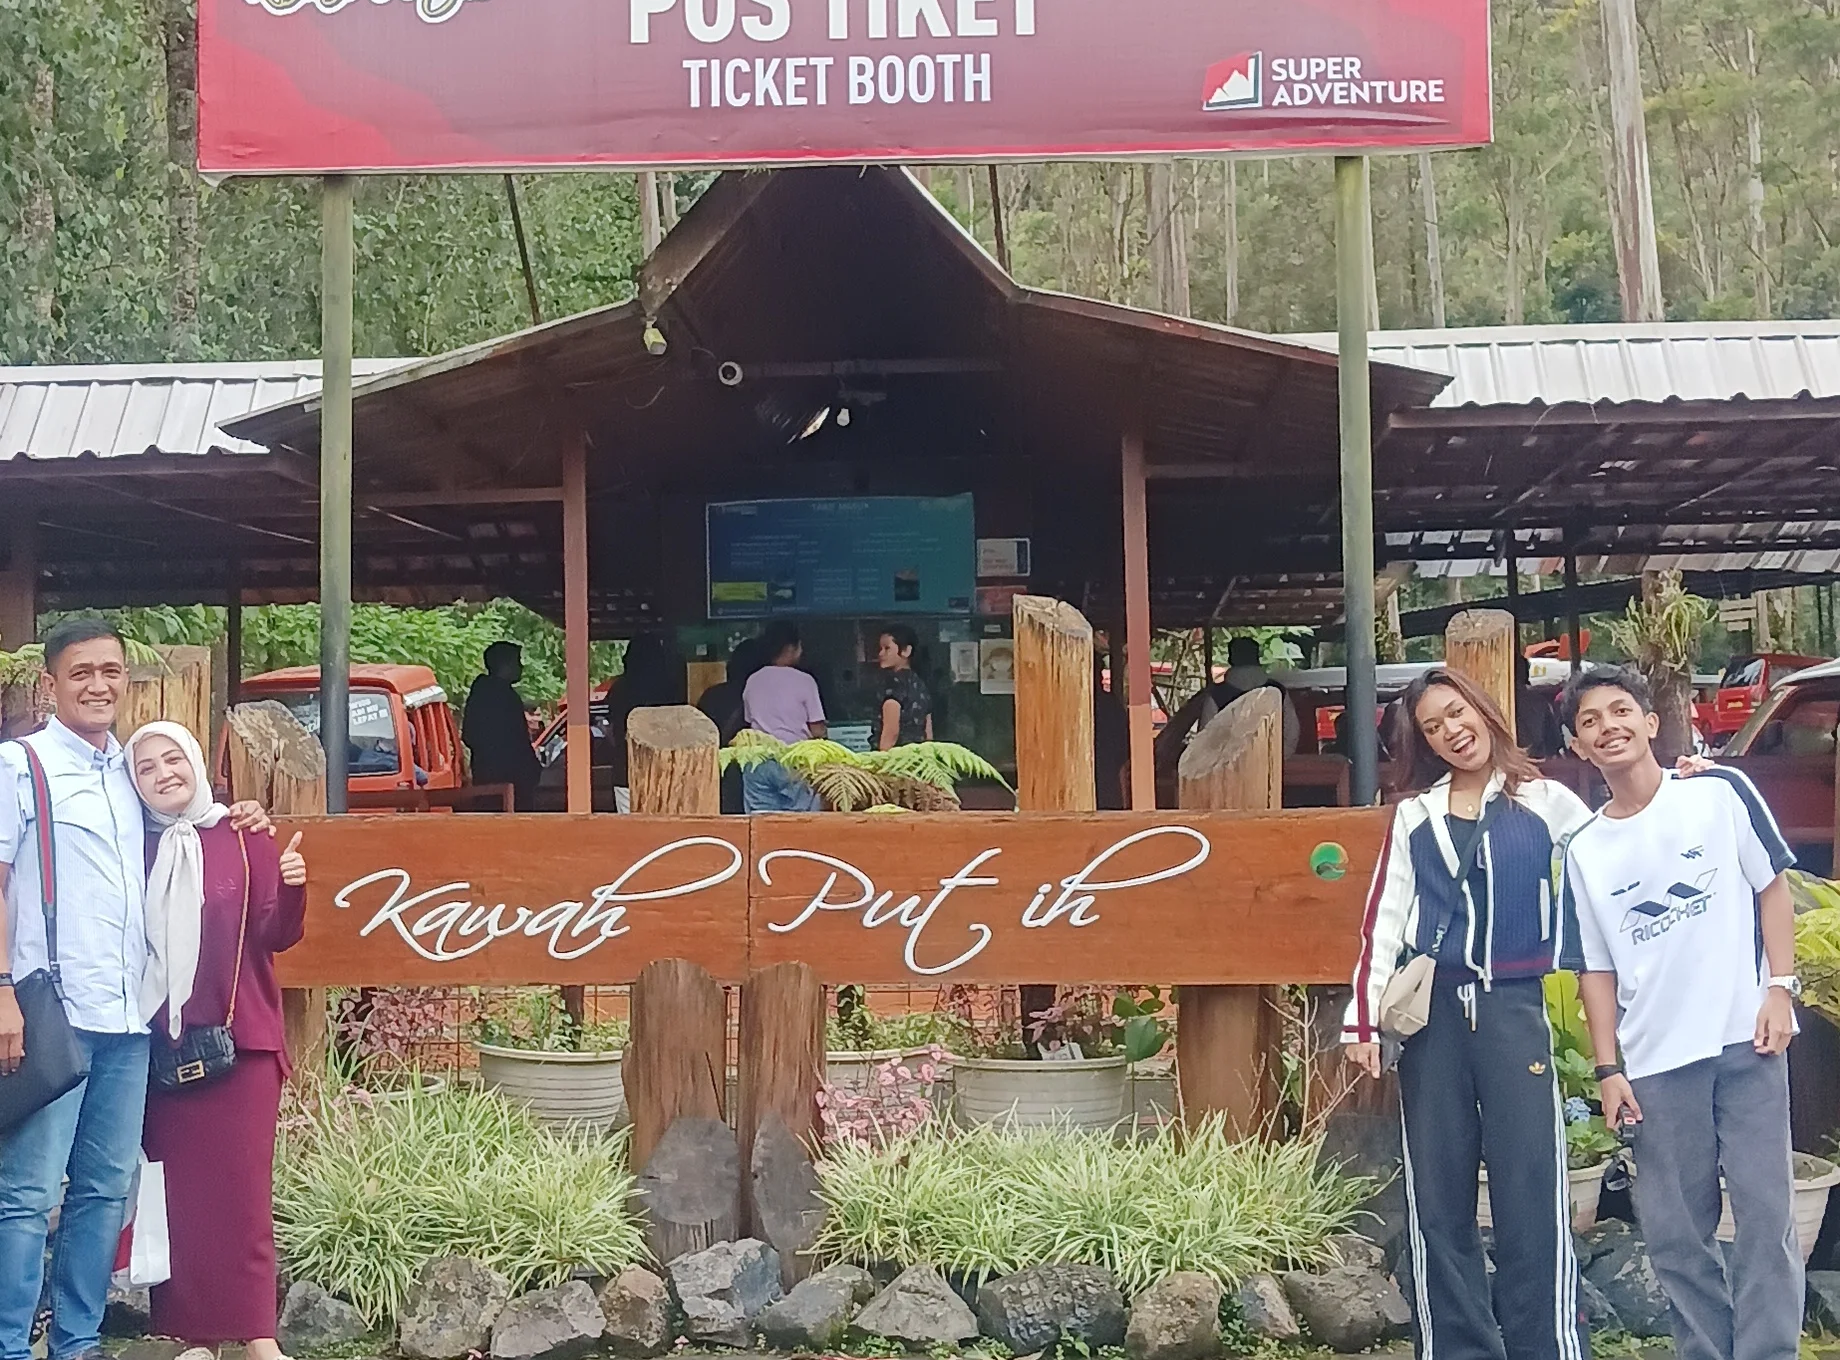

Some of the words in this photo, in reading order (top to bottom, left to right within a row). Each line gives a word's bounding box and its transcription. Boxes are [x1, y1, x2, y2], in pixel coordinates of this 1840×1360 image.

[682, 56, 834, 108] TICKET
[848, 53, 992, 105] BOOTH
[1271, 56, 1362, 82] SUPER
[1271, 79, 1446, 107] ADVENTURE
[334, 836, 743, 962] Kawah
